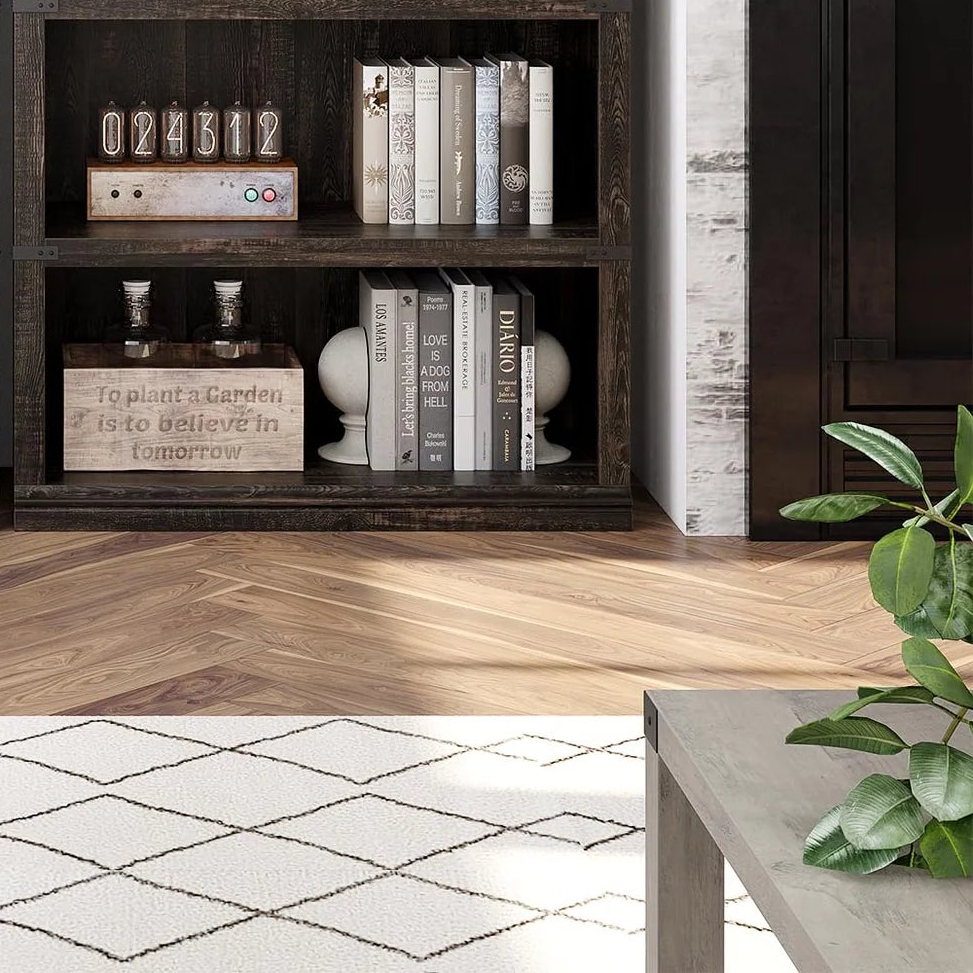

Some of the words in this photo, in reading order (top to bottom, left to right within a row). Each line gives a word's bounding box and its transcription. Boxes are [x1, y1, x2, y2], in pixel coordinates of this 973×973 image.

[453, 85, 463, 114] Dreaming
[454, 122, 462, 146] Sweden
[375, 302, 387, 320] LOS
[461, 290, 469, 339] REAL-ESTATE
[375, 321, 387, 363] AMANTES
[401, 321, 415, 353] home!
[423, 334, 448, 346] LOVE
[499, 310, 519, 373] DIÁRIO
[431, 350, 440, 361] IS
[461, 341, 469, 390] BROKERAGE
[401, 354, 415, 385] blacks
[420, 365, 428, 377] A
[429, 365, 450, 377] DOG
[96, 385, 121, 404] To
[126, 384, 182, 407] plant
[187, 389, 200, 404] a
[205, 384, 283, 404] Garden
[422, 381, 449, 392] FROM
[401, 386, 418, 413] bring
[424, 396, 448, 408] HELL
[97, 413, 117, 433] is
[126, 415, 150, 433] to
[158, 413, 249, 433] believe
[255, 413, 279, 433] in
[401, 414, 415, 437] Let's
[131, 442, 243, 461] tomorrow
